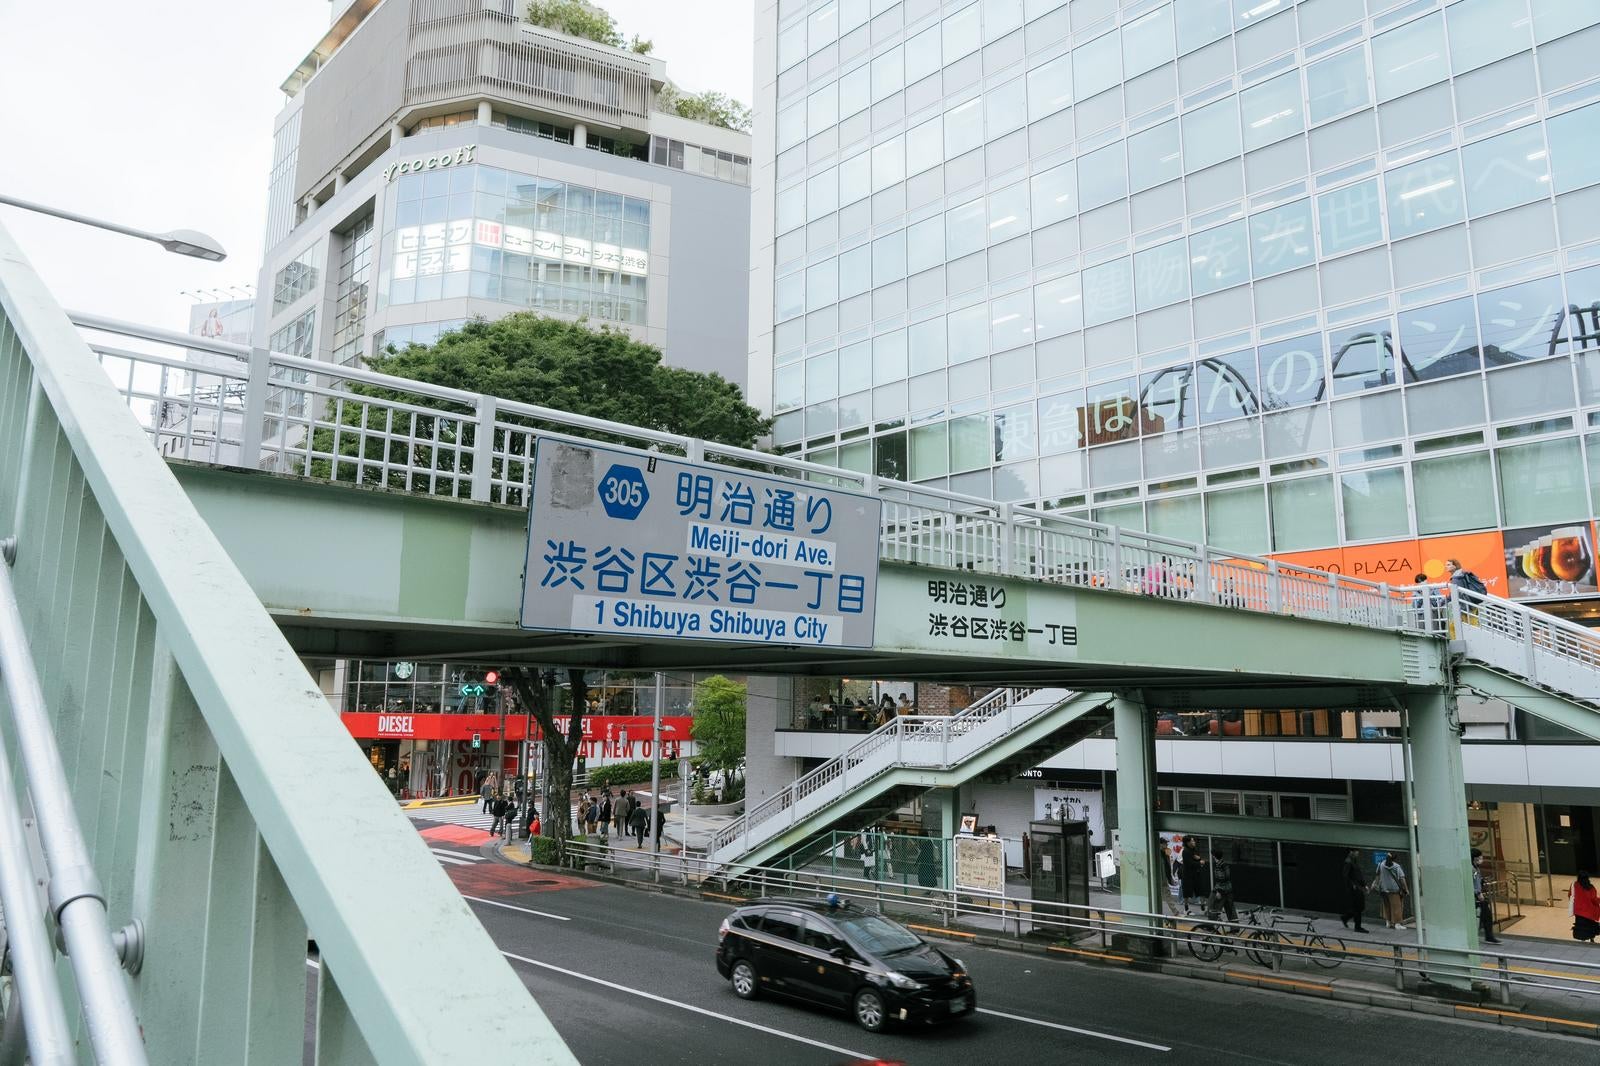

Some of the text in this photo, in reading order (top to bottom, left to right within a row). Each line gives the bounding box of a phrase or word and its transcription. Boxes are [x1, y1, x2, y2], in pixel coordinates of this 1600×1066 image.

[604, 472, 833, 534] 305 明治通り
[691, 525, 832, 566] Meiji-dori Ave.
[541, 539, 864, 614] 渋谷区渋谷一丁目
[1354, 558, 1412, 576] PLAZA
[928, 580, 1006, 609] 明治通り
[594, 602, 828, 643] 1 Shibuya Shibuya City
[929, 613, 1077, 646] 渋谷区渋谷一丁目
[378, 715, 414, 732] DIESEL
[552, 717, 593, 734] DIEEL
[575, 740, 681, 759] AT NEW OEN
